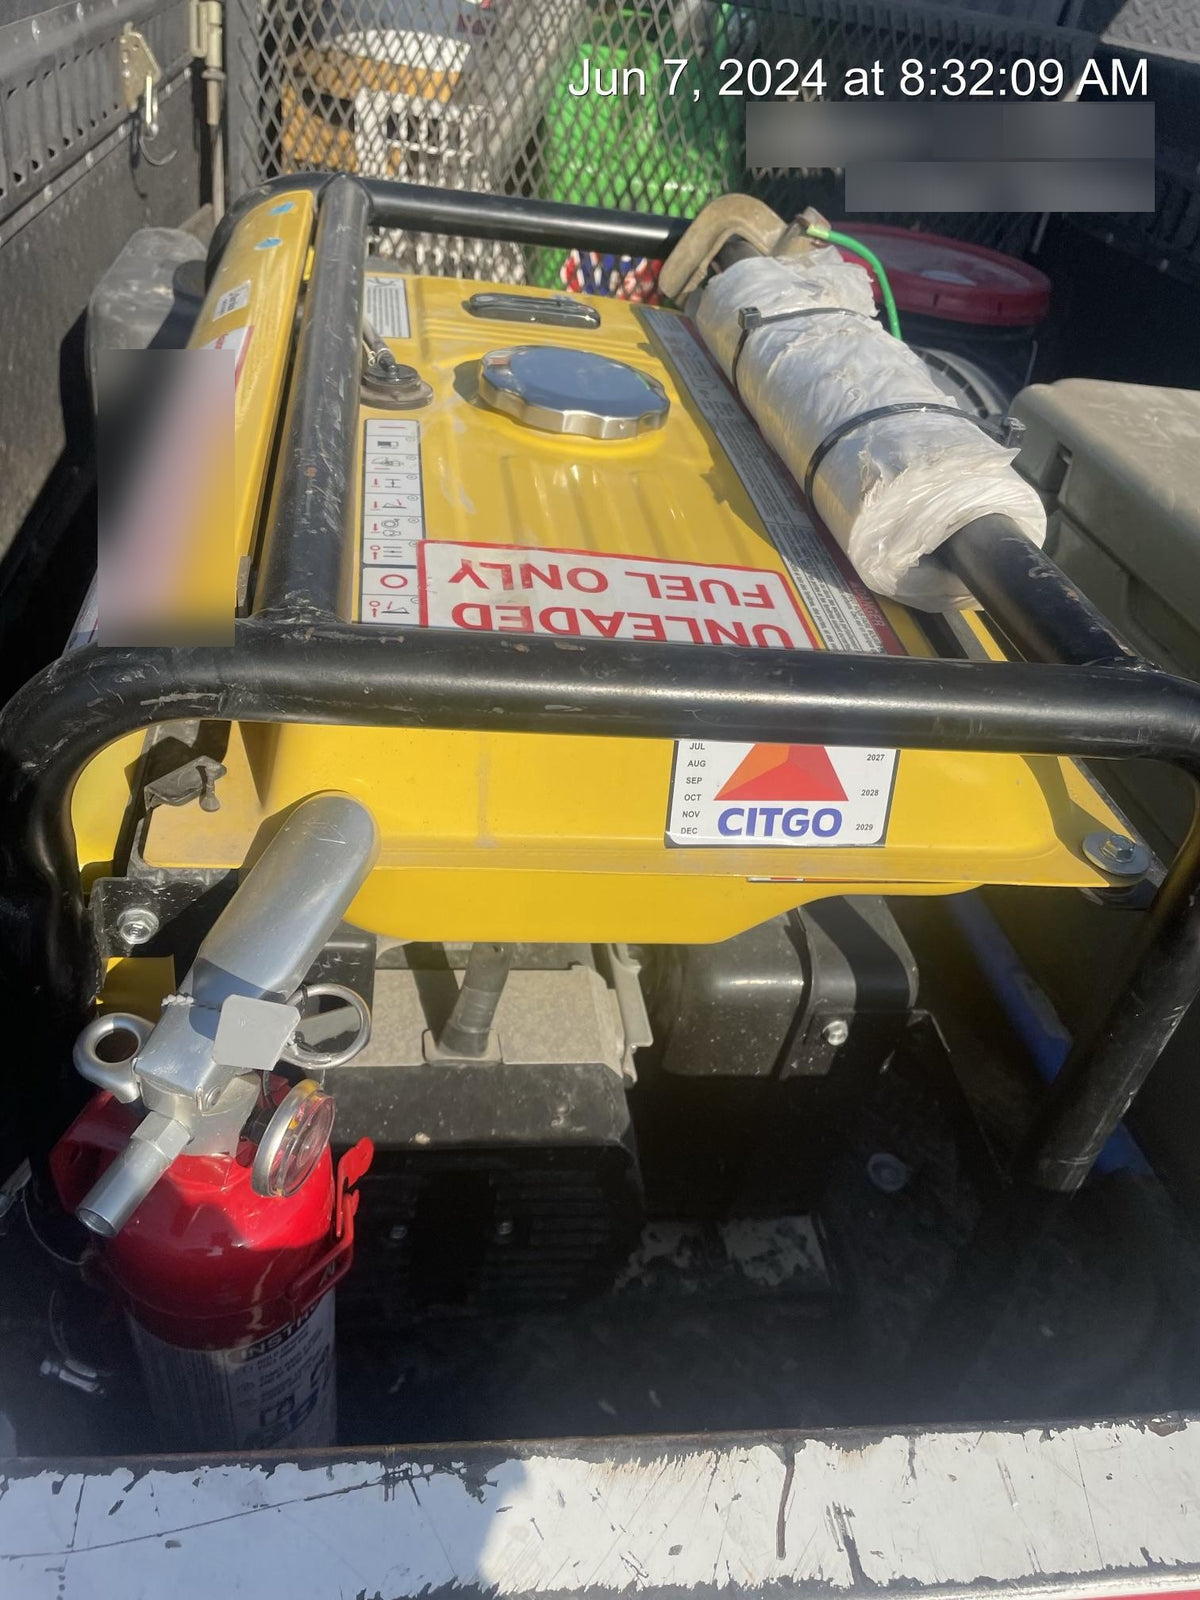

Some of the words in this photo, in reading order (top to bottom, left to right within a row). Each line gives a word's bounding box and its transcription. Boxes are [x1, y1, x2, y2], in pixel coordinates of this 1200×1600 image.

[447, 557, 610, 595] ONLY
[624, 570, 776, 610] FUEL
[451, 602, 796, 649] UNLEADED
[690, 742, 706, 750] JUL
[866, 753, 885, 761] 2027
[687, 759, 706, 768] AUG
[685, 776, 703, 784] SEP
[861, 788, 879, 797] 2028
[683, 793, 702, 801] OCT
[682, 810, 700, 818] NOV
[717, 807, 843, 838] CITGO
[680, 826, 698, 834] DEC
[854, 823, 873, 831] 2029
